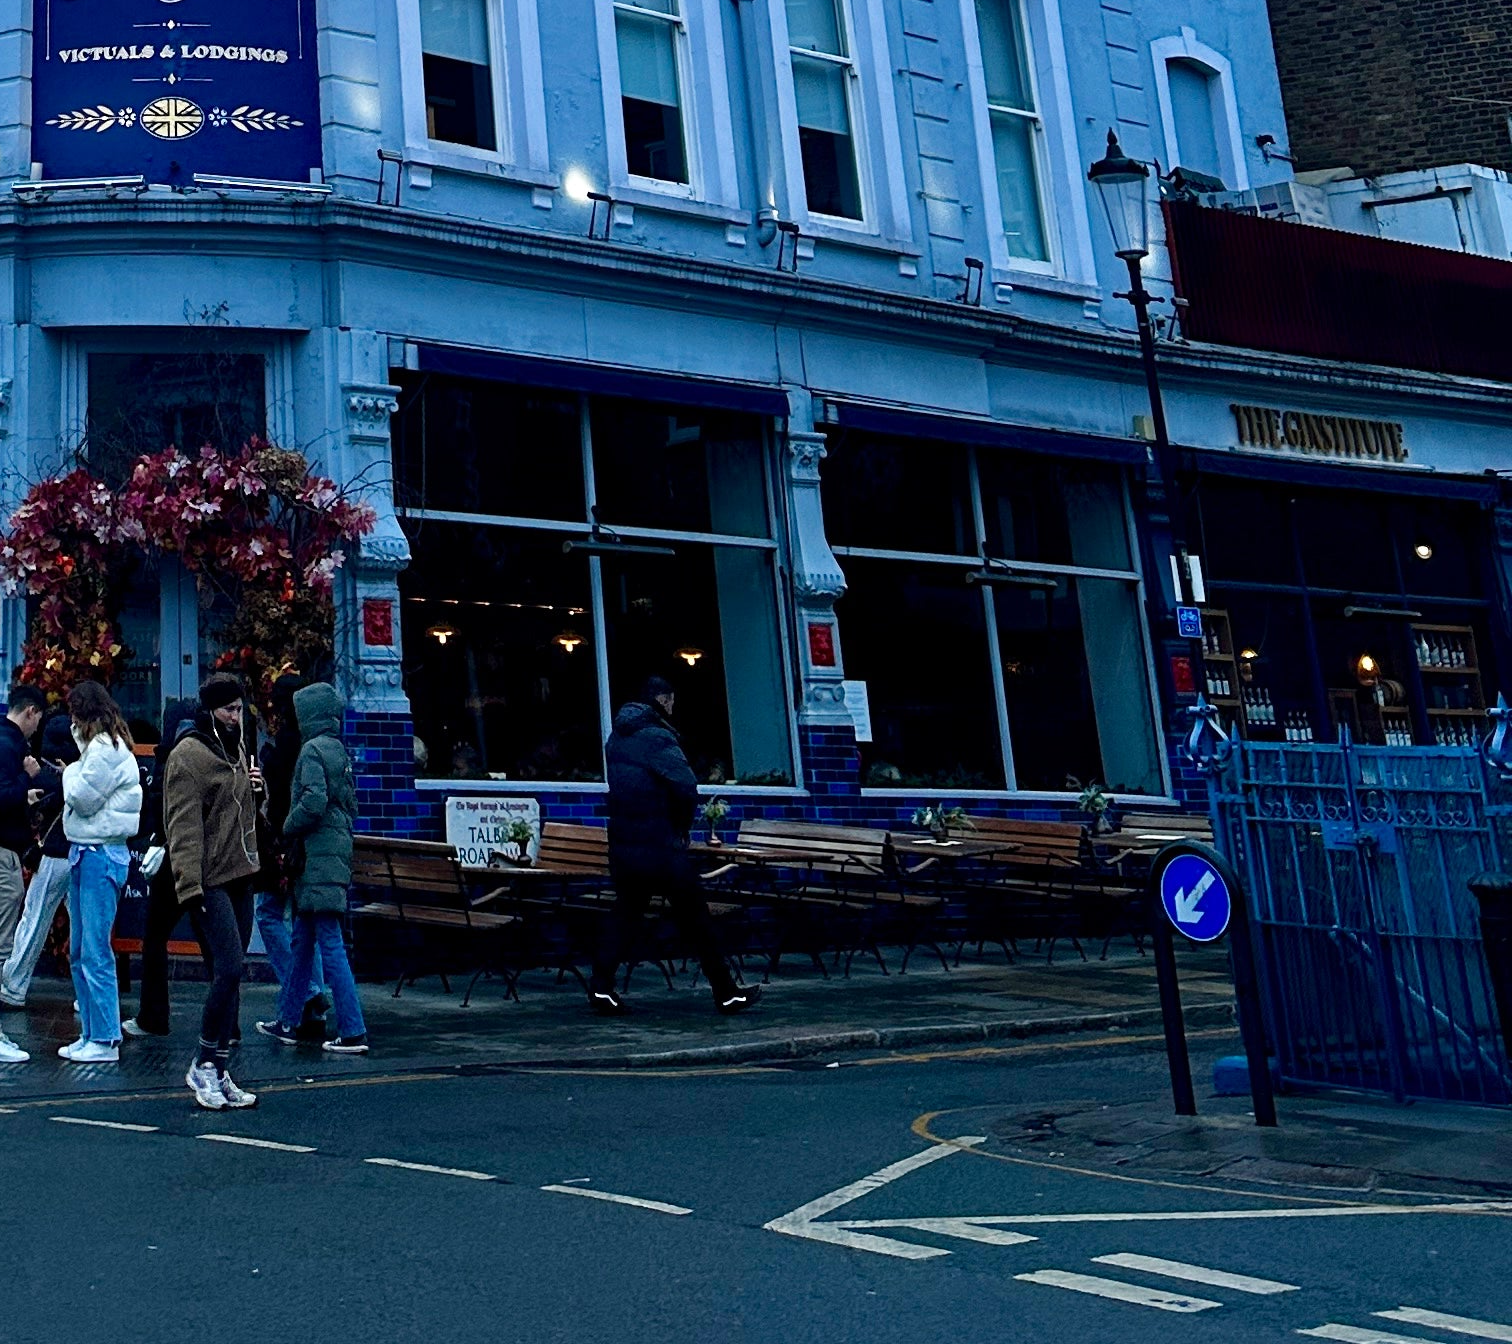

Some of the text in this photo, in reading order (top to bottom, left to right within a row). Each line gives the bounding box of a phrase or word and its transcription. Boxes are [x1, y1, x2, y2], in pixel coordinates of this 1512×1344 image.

[59, 45, 288, 64] VICTUALS & LODGINGS
[1229, 403, 1285, 449] THE
[468, 827, 511, 844] TALB
